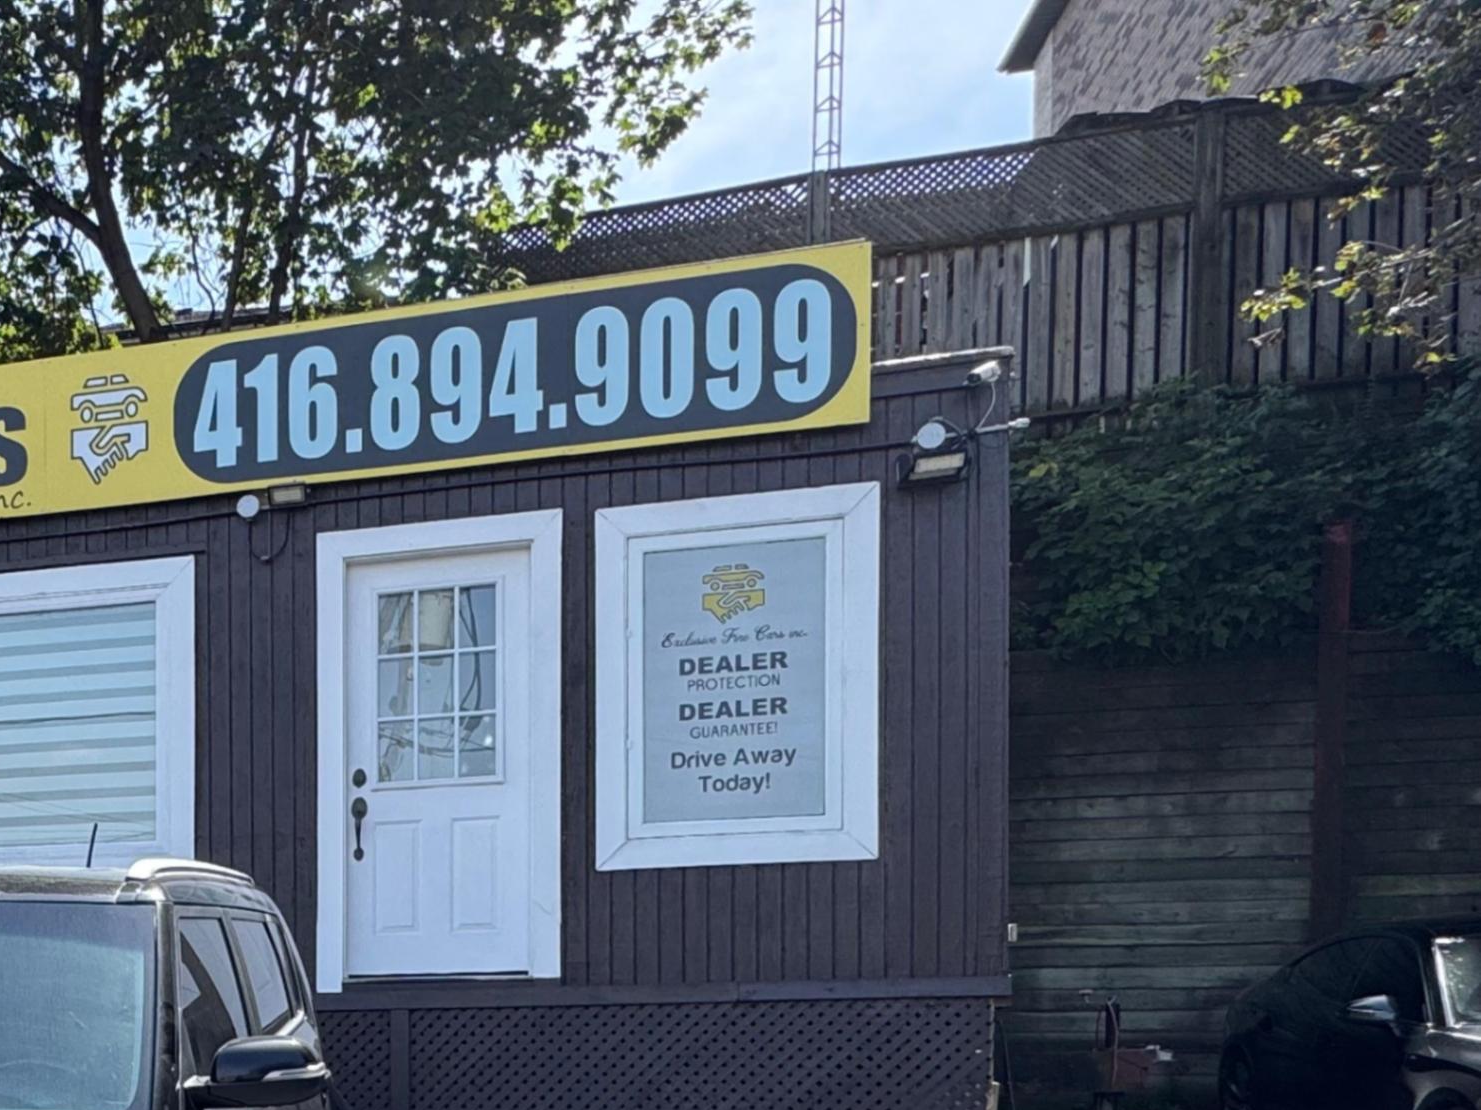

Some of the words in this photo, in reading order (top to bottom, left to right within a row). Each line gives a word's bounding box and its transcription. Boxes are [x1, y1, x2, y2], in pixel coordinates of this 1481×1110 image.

[192, 277, 836, 470] 416.894.9099
[679, 651, 789, 676] DEALER
[687, 673, 781, 692] PROTECTION
[679, 697, 788, 721] DEALER
[689, 721, 779, 739] GUARANTEE!
[671, 751, 727, 769] Drive
[733, 748, 797, 767] Away
[698, 772, 771, 794] Today!
